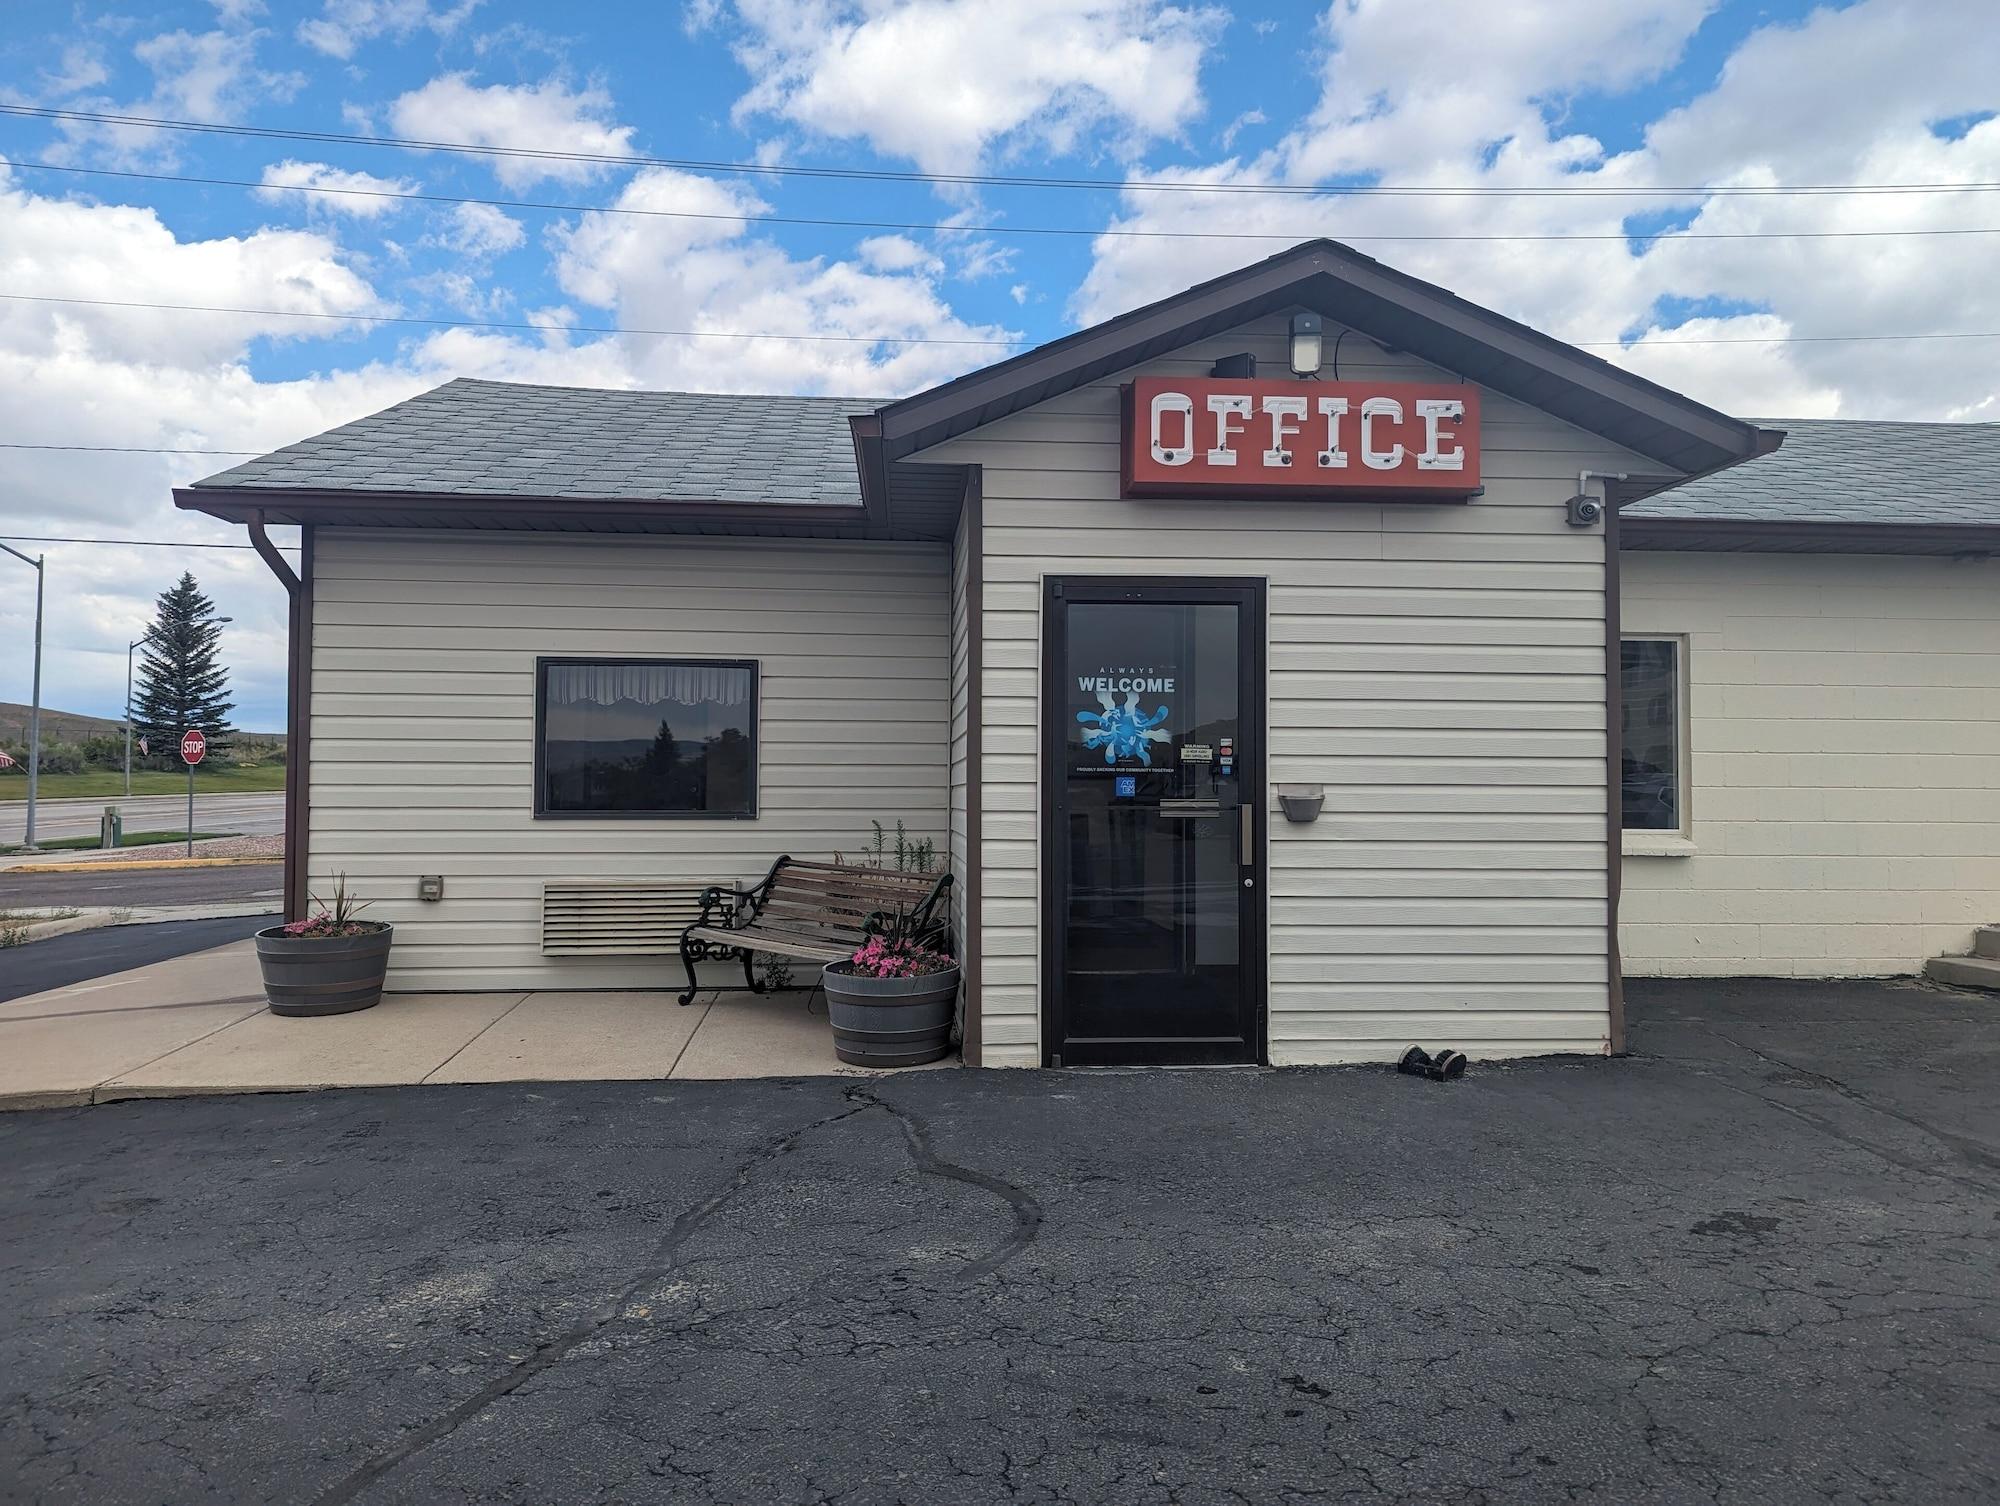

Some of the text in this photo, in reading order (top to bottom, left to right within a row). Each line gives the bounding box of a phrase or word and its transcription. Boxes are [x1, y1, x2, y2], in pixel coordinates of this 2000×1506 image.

[1150, 392, 1466, 470] OFFICE
[1078, 677, 1175, 693] WELCOME
[183, 741, 203, 754] STOP
